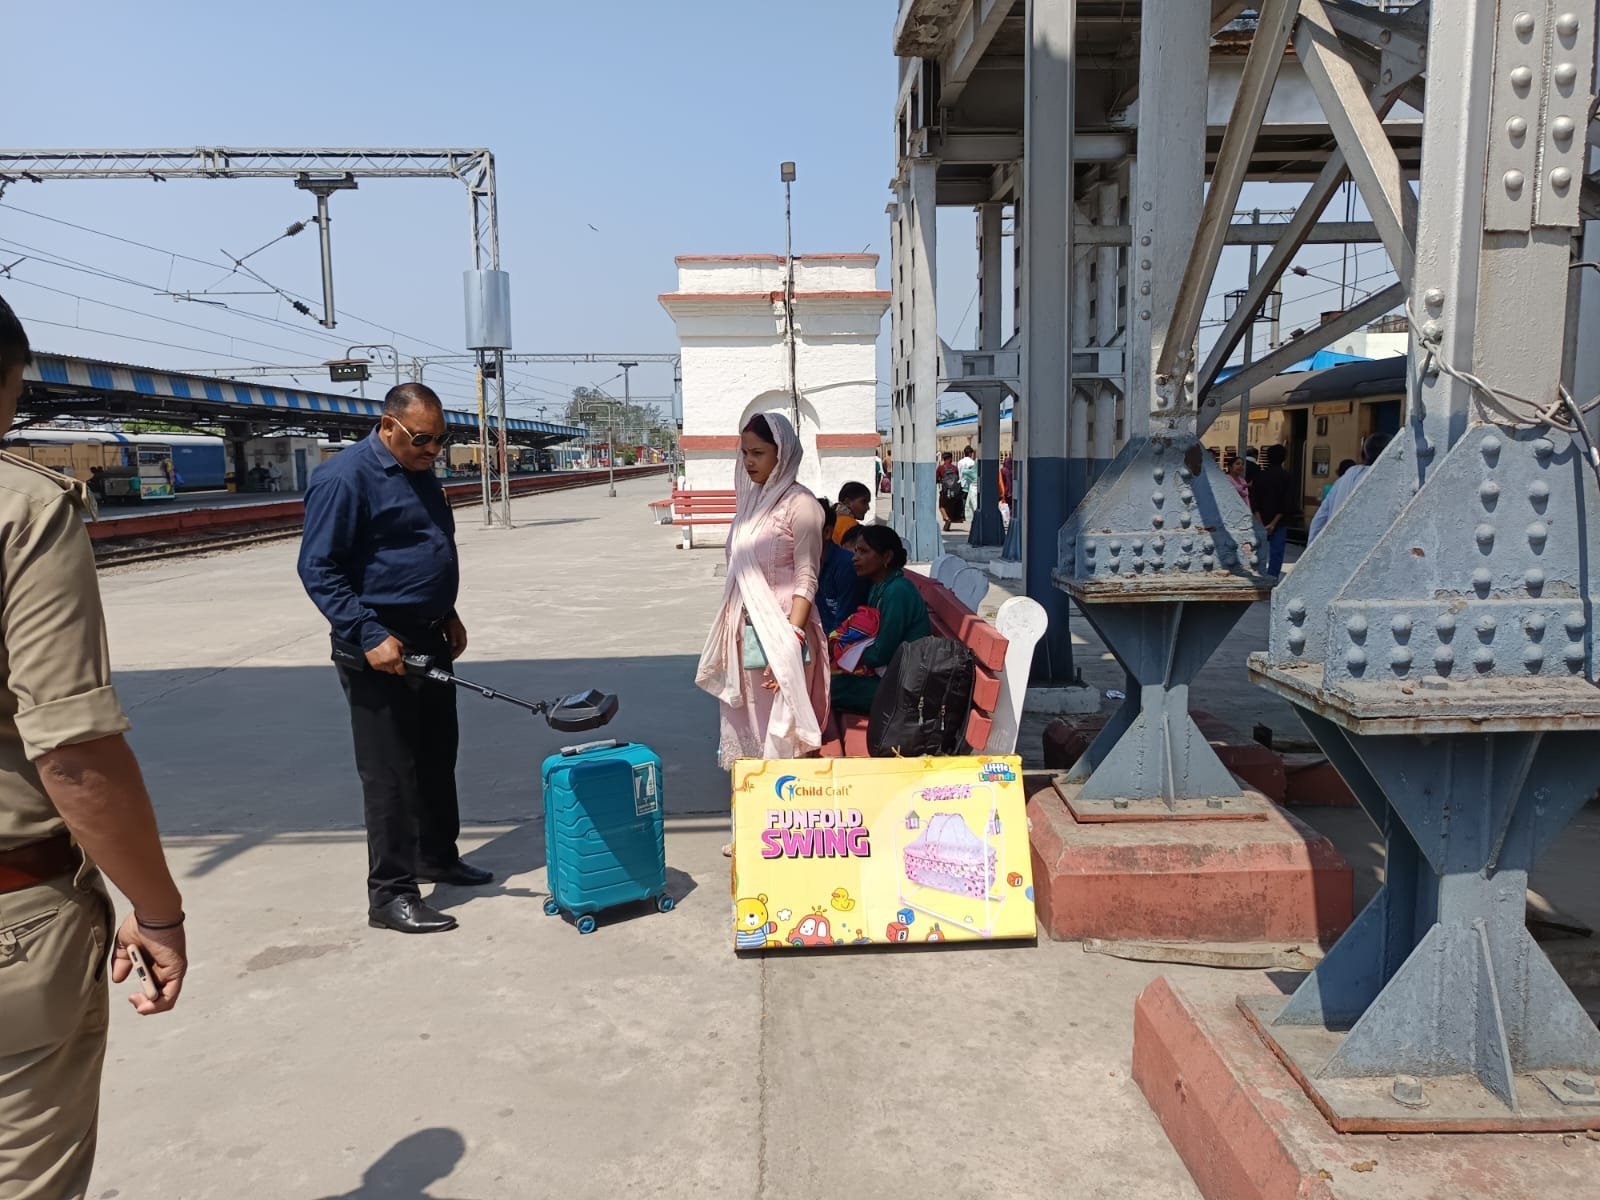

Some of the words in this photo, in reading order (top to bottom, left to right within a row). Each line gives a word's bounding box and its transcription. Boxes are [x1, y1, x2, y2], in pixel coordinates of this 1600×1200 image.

[984, 763, 1010, 773] Little
[795, 786, 823, 796] Child
[767, 808, 863, 829] FUNFOLD
[761, 827, 871, 859] SWING
